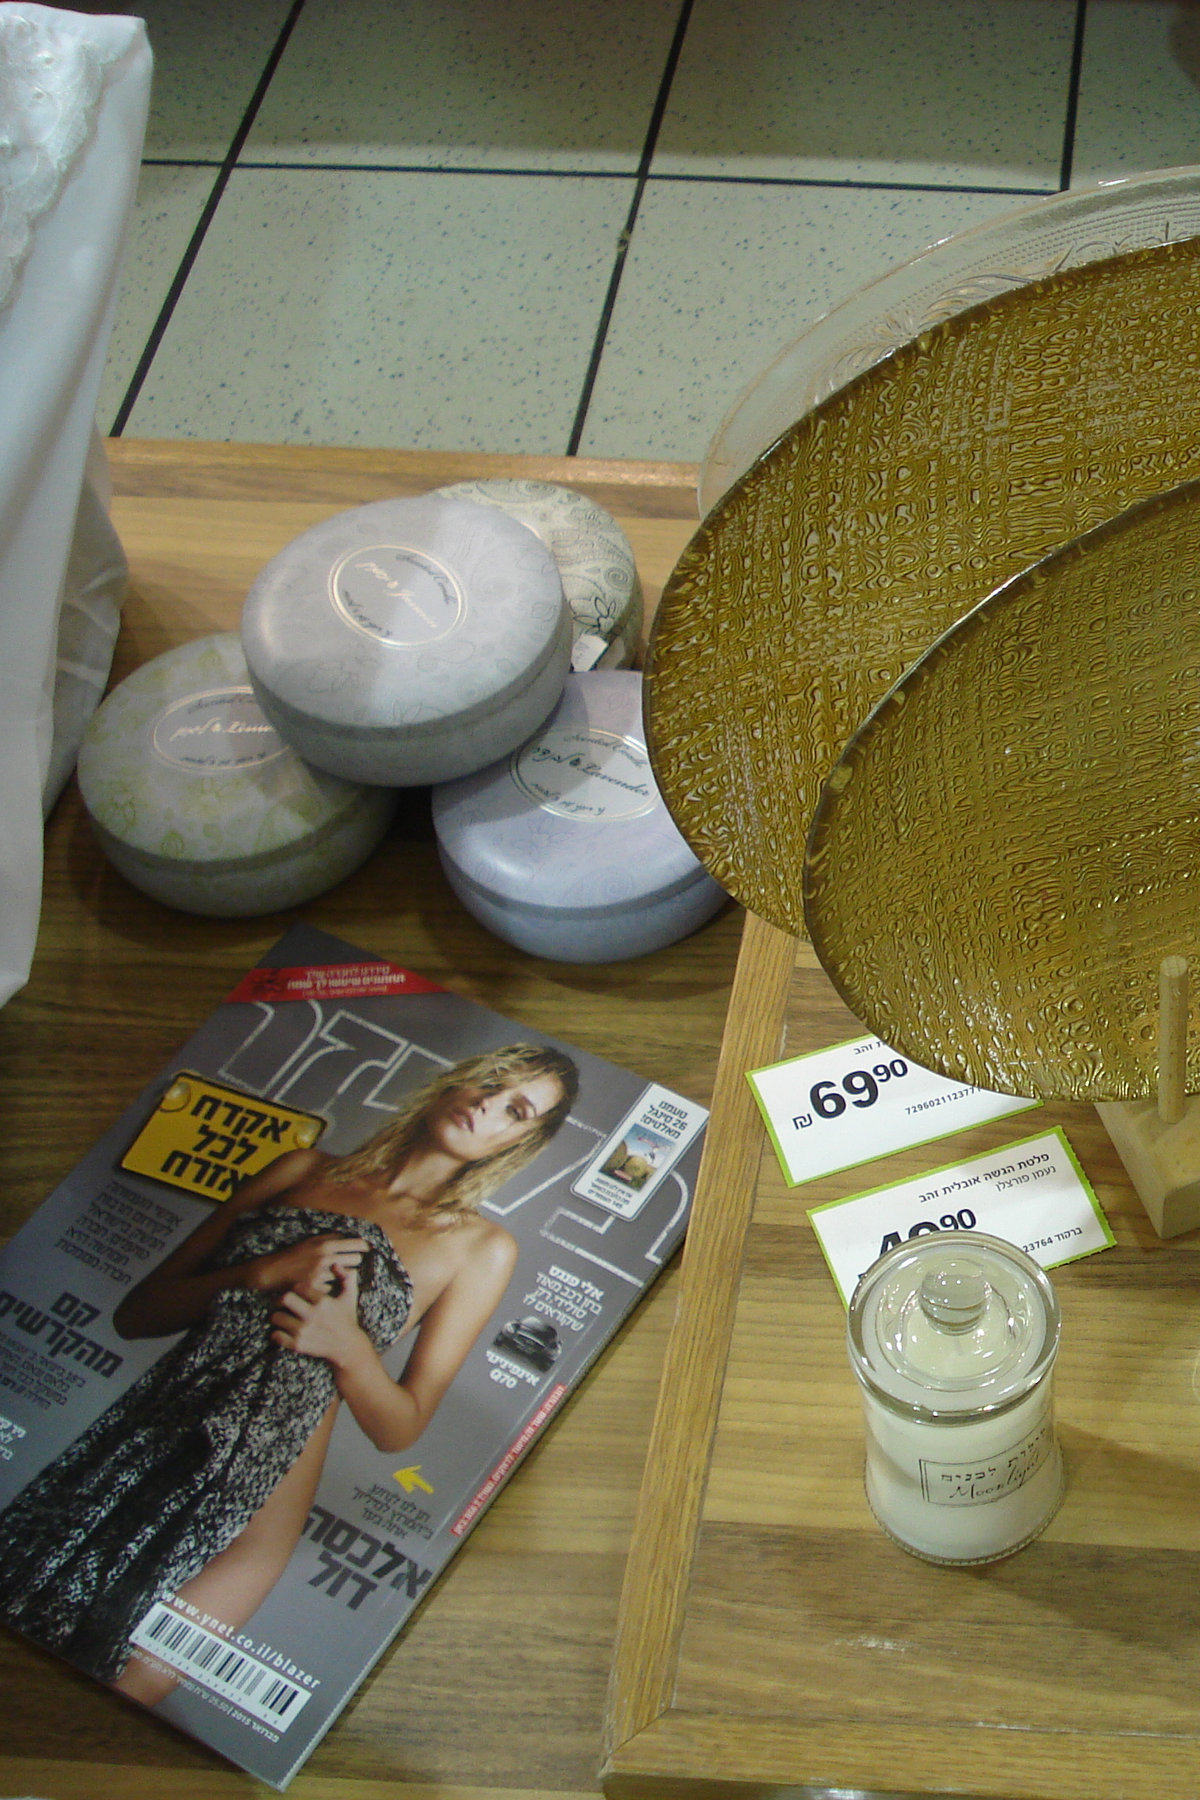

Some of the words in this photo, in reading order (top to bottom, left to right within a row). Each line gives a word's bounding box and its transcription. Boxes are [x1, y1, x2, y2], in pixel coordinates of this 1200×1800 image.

[190, 1094, 292, 1143] אקדח
[647, 1104, 673, 1124] סינגל
[658, 1100, 688, 1119] טעמנו
[671, 1118, 688, 1131] 26
[193, 1124, 259, 1165] לכל
[1018, 1152, 1051, 1169] פלטת
[160, 1150, 244, 1193] אזרח
[983, 1164, 1016, 1181] הגשה
[1032, 1165, 1057, 1181] נעמן
[942, 1176, 981, 1196] אובלית
[995, 1174, 1030, 1193] פורצלן
[918, 1190, 940, 1203] זהב
[1055, 1226, 1083, 1243] ברקוד
[580, 1281, 605, 1301] אלי
[50, 1291, 101, 1328] קם
[489, 1367, 518, 1389] Q70
[940, 1466, 997, 1482] לבנים
[301, 1504, 433, 1600] אלכסה
[308, 1550, 378, 1611] דול
[160, 1588, 321, 1690] www.ynet.co.il/blazer
[230, 1708, 252, 1727] 2015
[252, 1719, 281, 1744] פברואר
